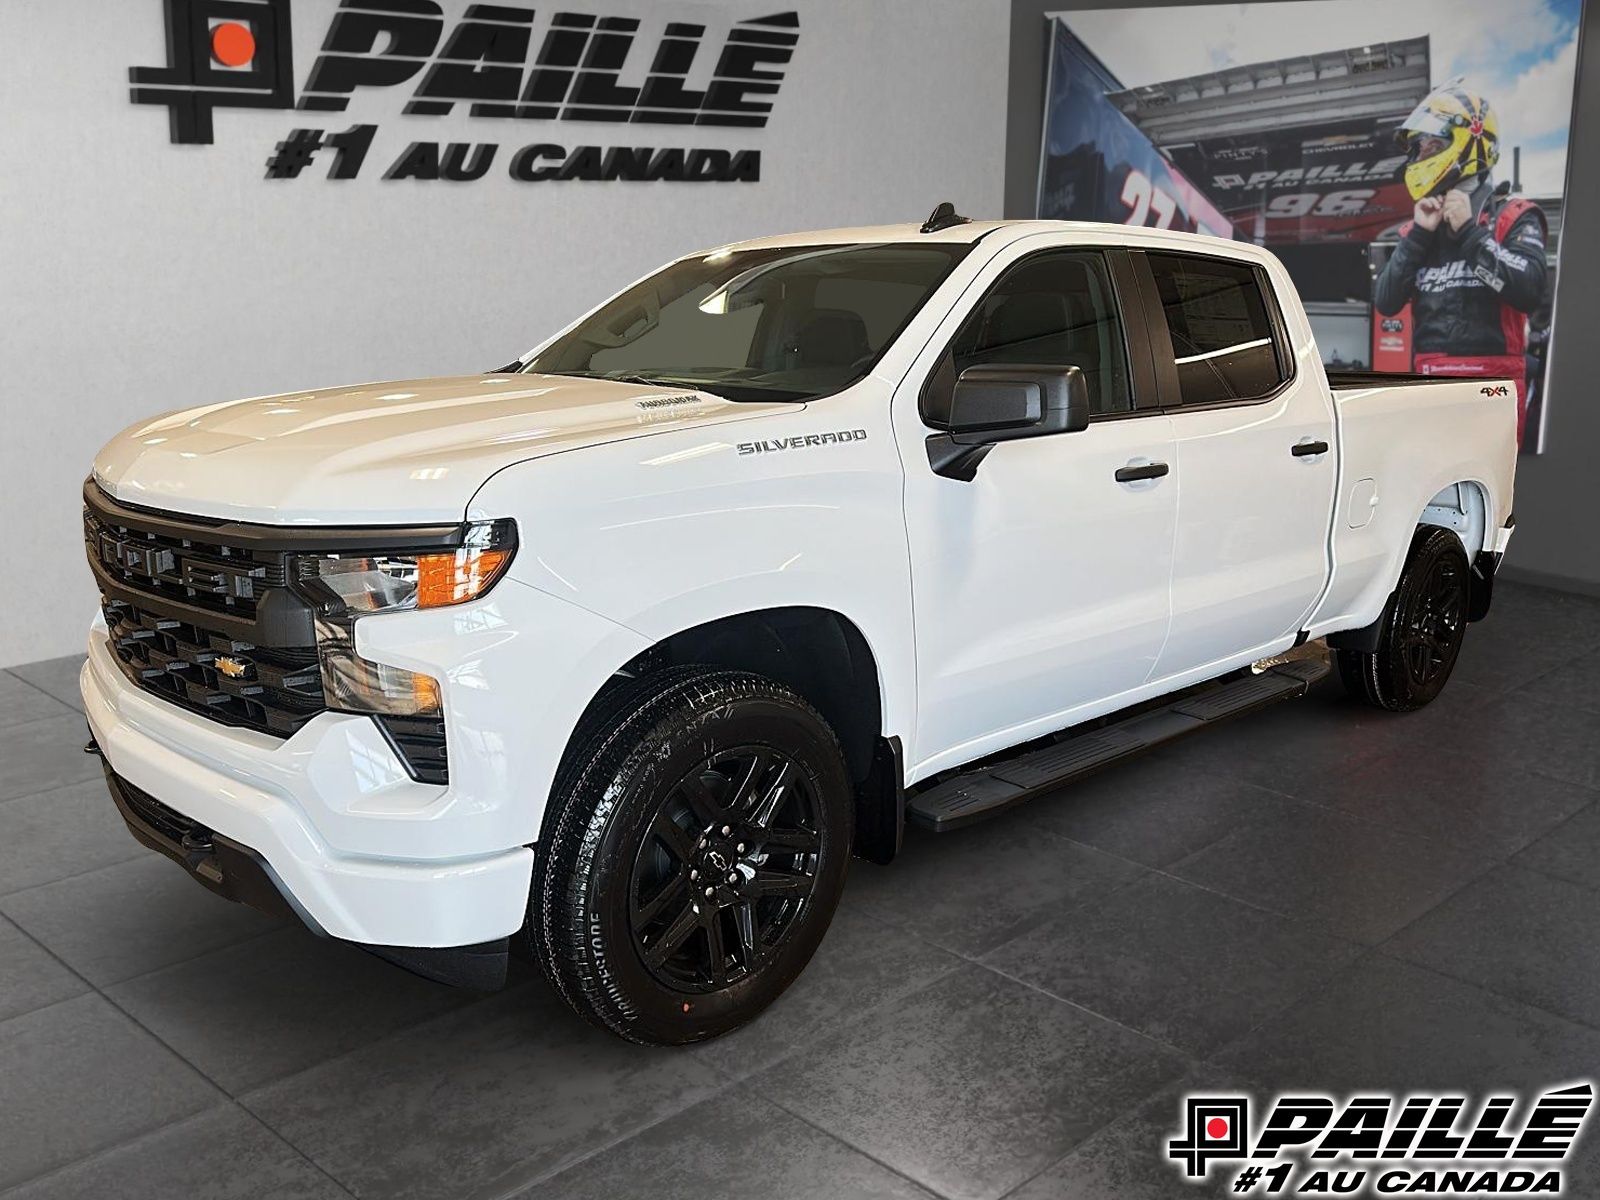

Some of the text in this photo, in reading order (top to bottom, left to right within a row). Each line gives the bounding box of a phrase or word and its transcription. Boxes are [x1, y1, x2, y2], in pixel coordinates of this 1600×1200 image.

[296, 0, 800, 128] PAILLÉ
[264, 124, 761, 183] #1 AU CANADA
[1271, 180, 1300, 188] AU
[1305, 172, 1395, 186] CANADA
[1265, 189, 1377, 219] 96
[736, 429, 868, 455] SILVERADO
